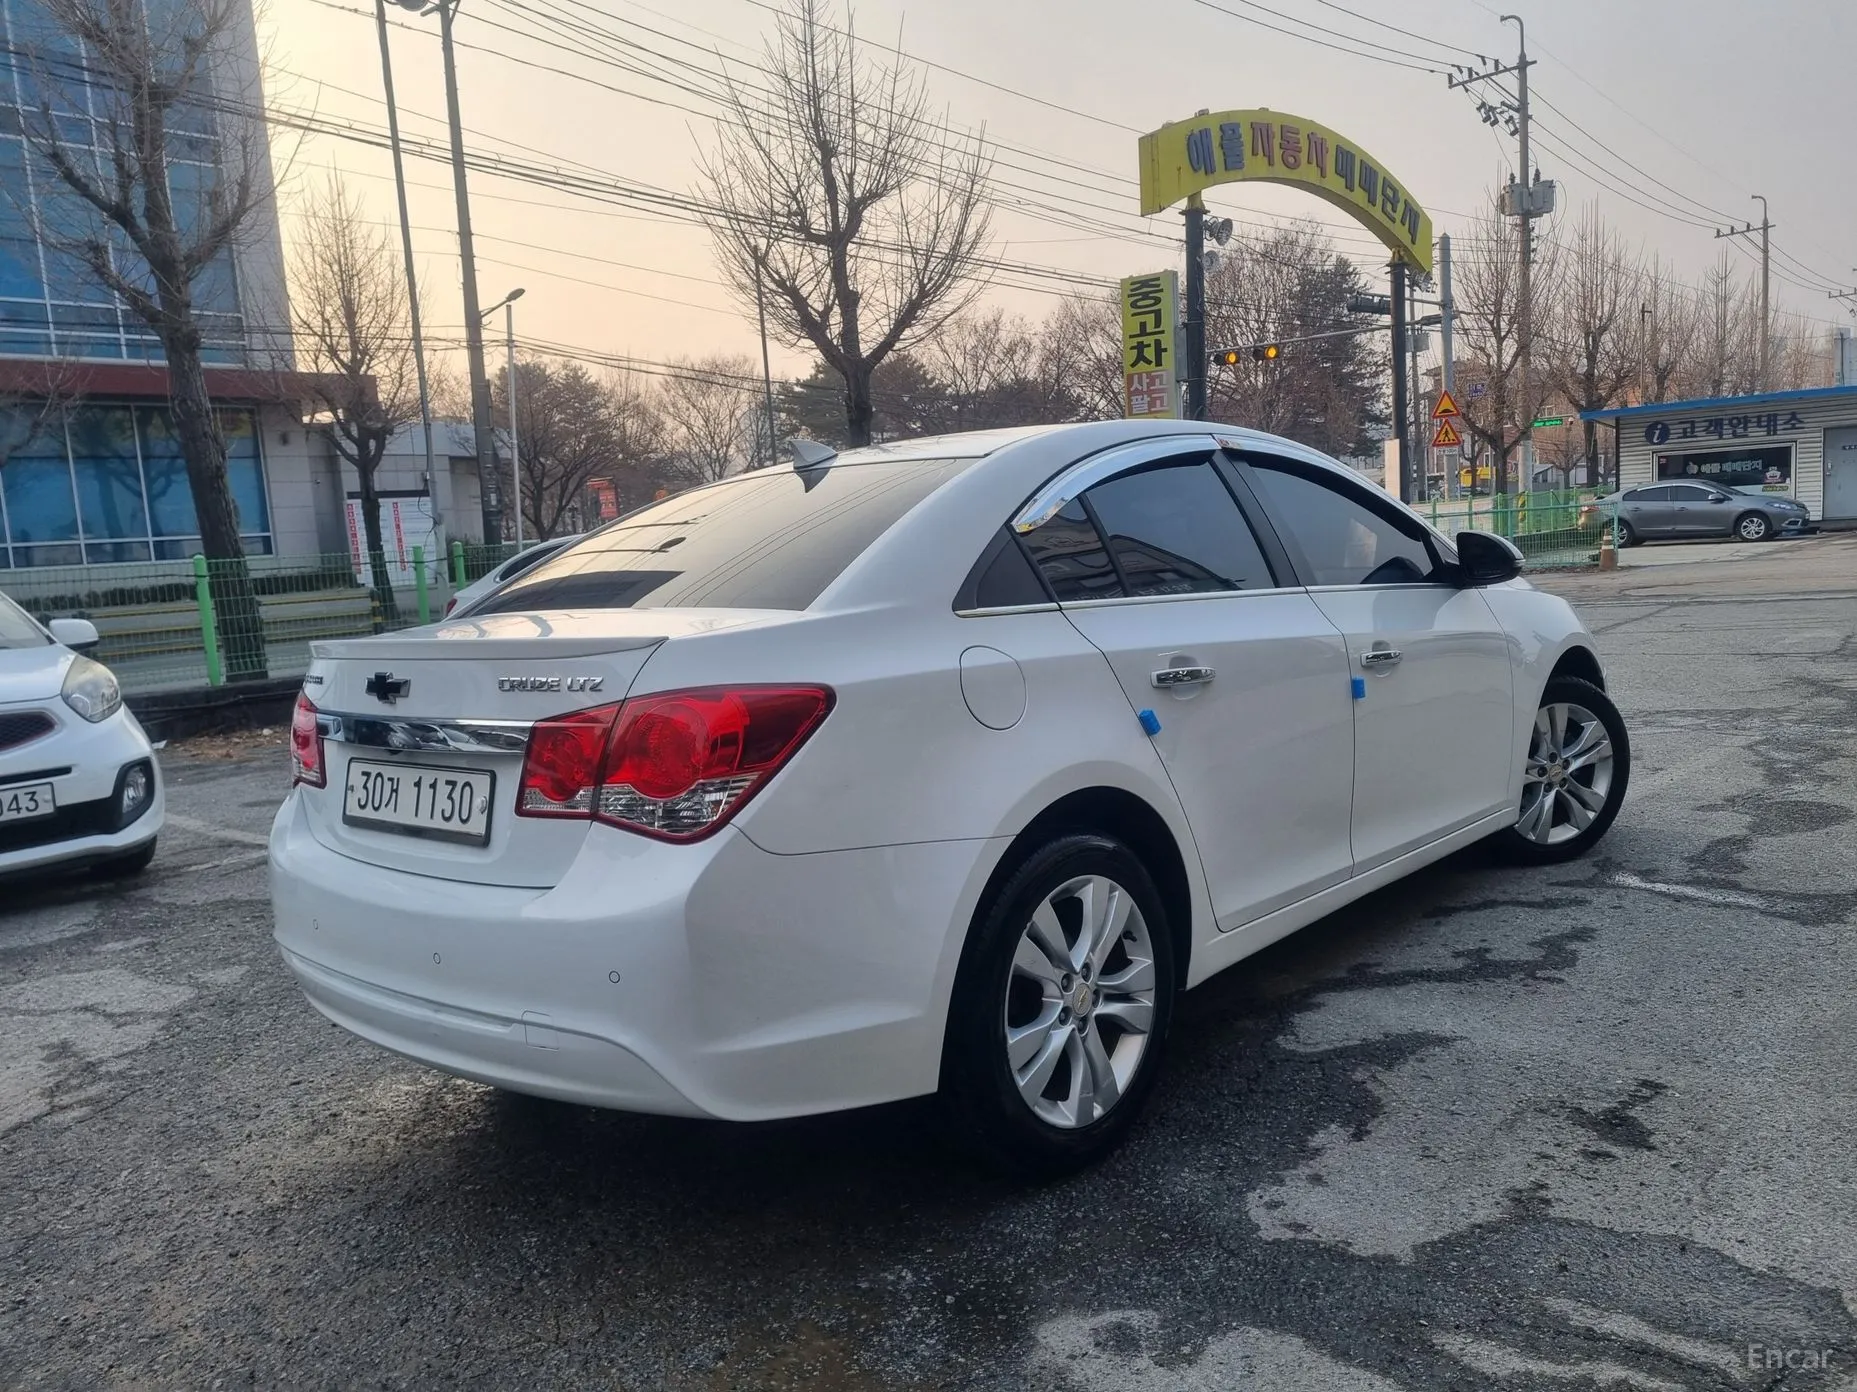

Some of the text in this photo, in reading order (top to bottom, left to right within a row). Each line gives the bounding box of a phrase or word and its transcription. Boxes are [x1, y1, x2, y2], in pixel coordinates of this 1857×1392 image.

[1187, 121, 1420, 245] 애플 자동차 매매단지
[1128, 276, 1168, 369] 중고차
[1130, 371, 1169, 391] 사고
[1130, 392, 1169, 415] 팔고
[1676, 411, 1805, 440] 고객안내소
[498, 677, 603, 692] CRUZE LTZ
[0, 791, 39, 816] 43
[357, 770, 474, 825] 30거 1130
